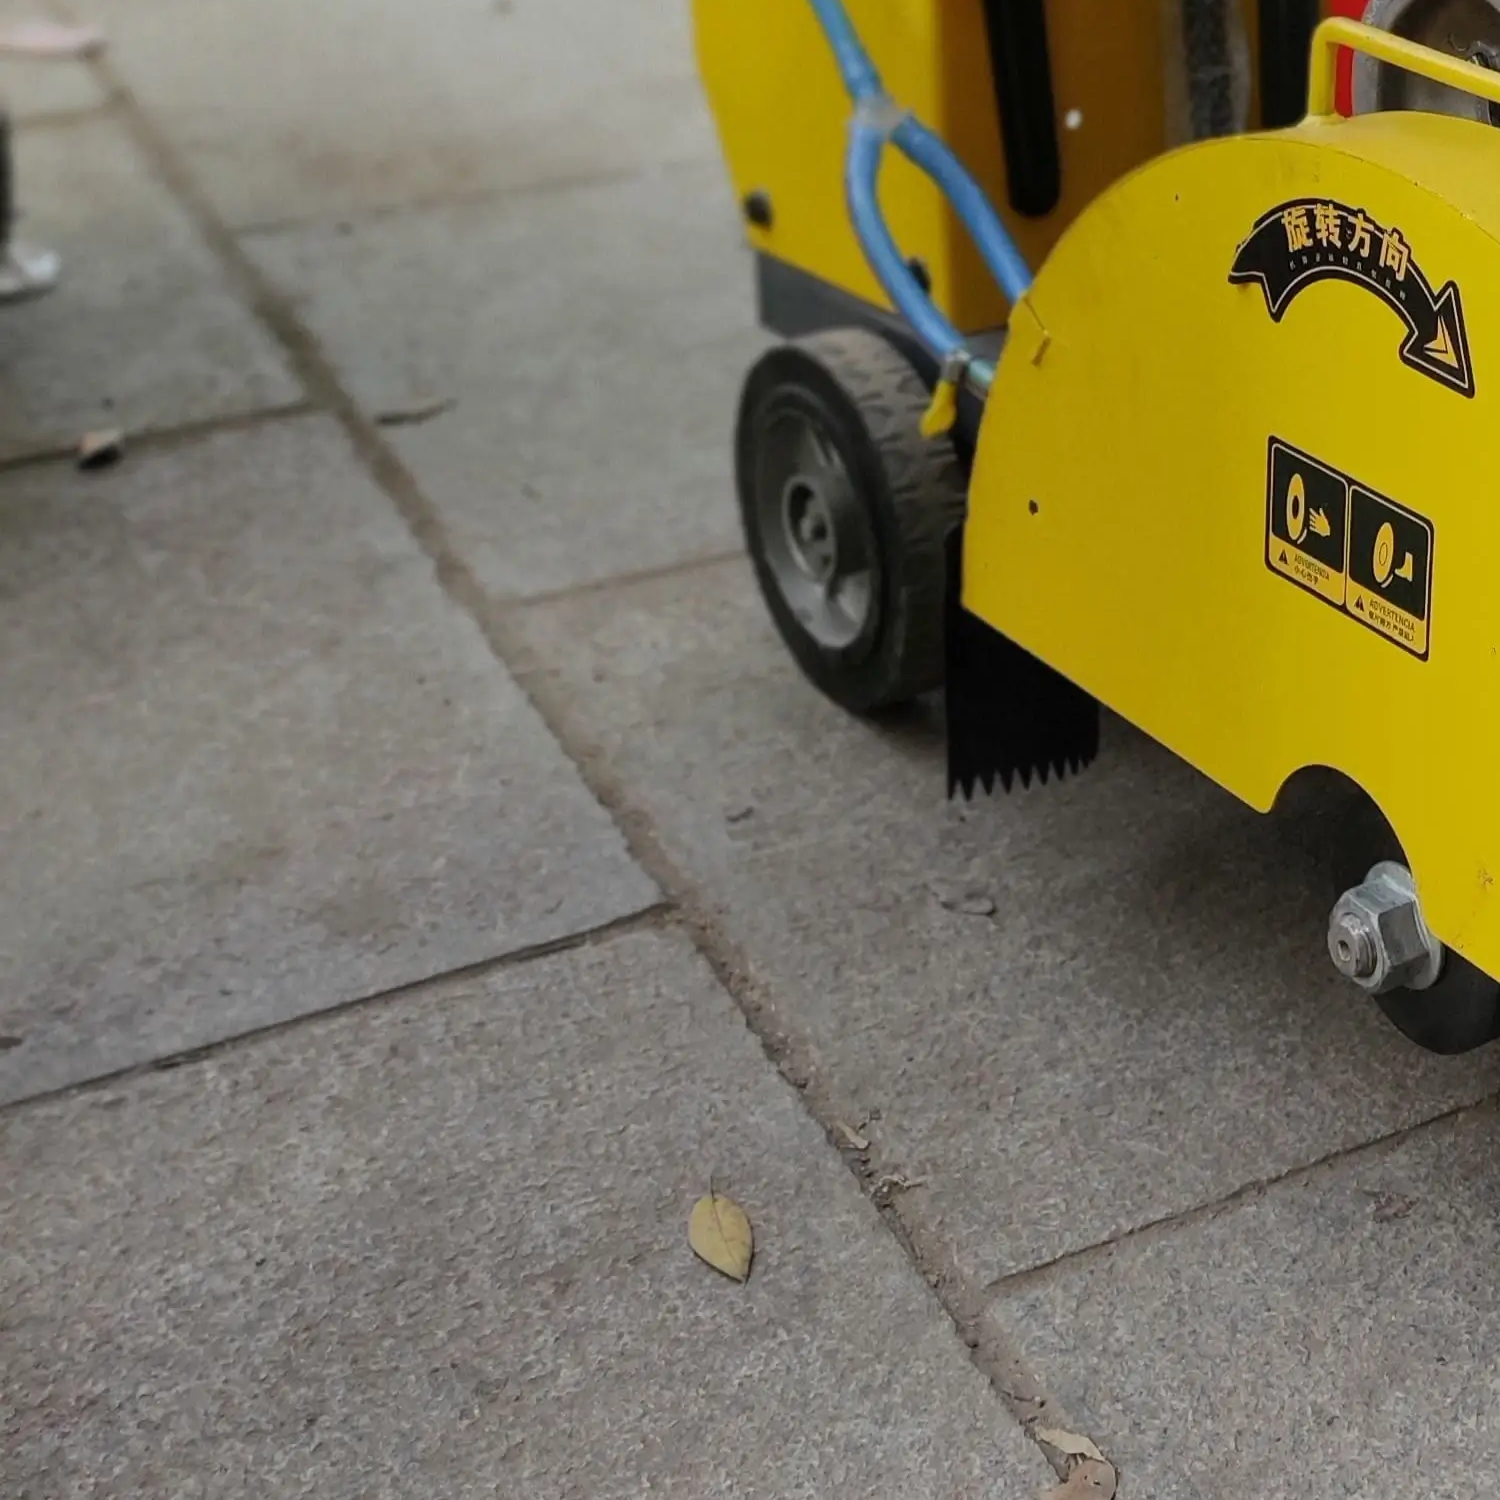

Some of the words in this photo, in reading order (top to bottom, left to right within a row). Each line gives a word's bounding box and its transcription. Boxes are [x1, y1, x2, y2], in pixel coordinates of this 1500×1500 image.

[1281, 203, 1409, 282] 旋转方向
[1369, 599, 1416, 632] ADVERTENCIA
